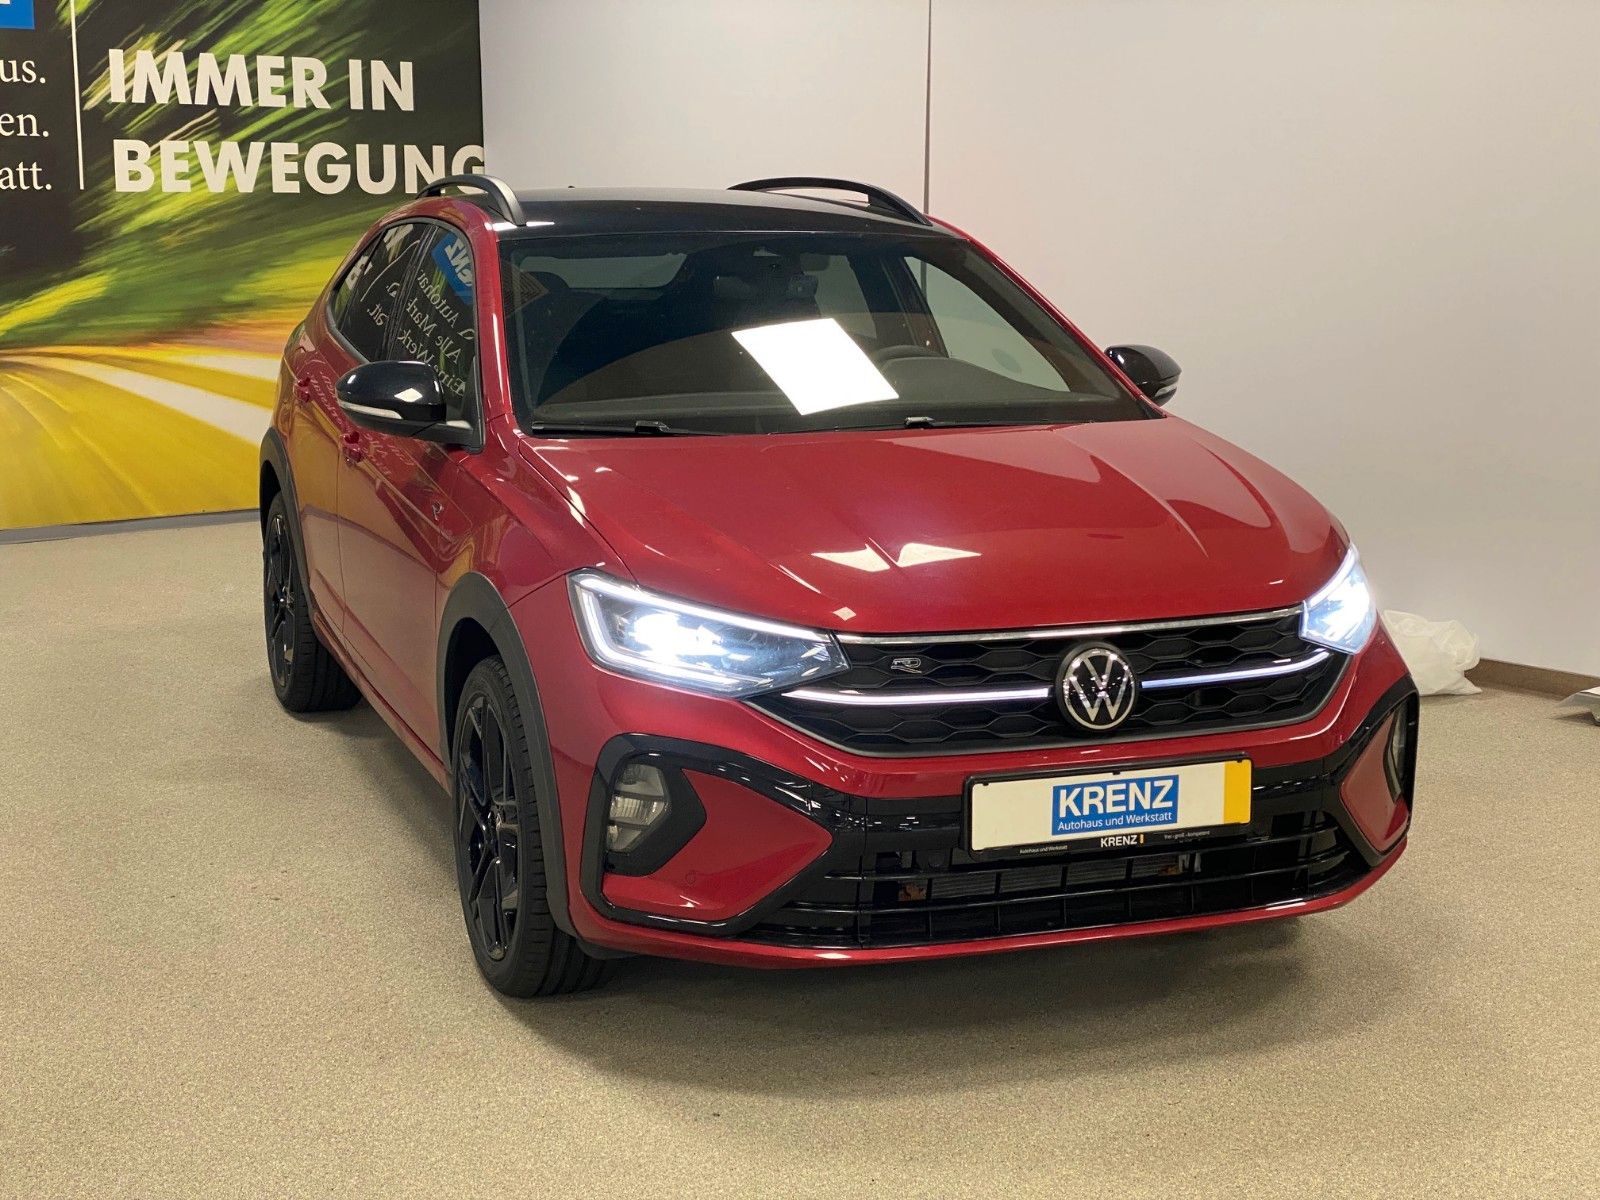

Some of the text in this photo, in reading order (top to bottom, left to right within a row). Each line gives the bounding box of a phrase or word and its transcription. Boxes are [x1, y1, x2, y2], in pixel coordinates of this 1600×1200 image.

[108, 49, 414, 112] IMMER IN
[0, 113, 50, 138] en.
[0, 161, 52, 190] att.
[113, 139, 486, 195] BEWEGUNG
[1059, 779, 1174, 818] KRENZ
[1057, 811, 1173, 831] Autohaus und Werkstatt
[1100, 834, 1138, 848] KRENZ
